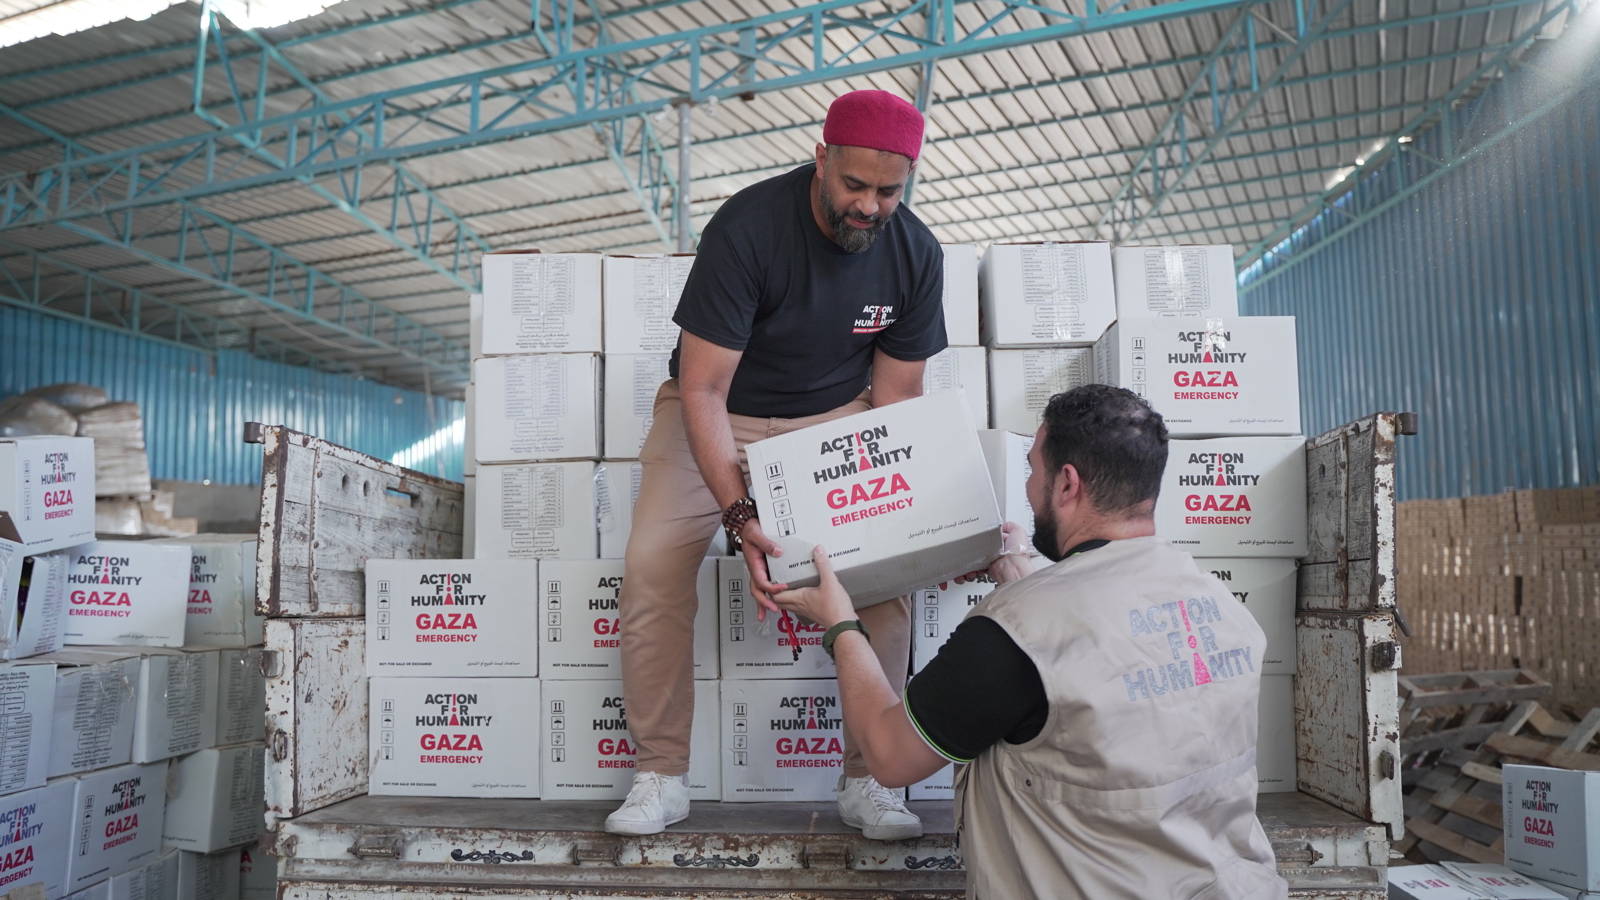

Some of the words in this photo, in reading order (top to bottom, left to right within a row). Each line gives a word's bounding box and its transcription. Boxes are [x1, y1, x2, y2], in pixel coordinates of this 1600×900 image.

[863, 305, 893, 314] ACTION
[1168, 351, 1247, 363] HUMANITY
[1174, 371, 1238, 387] GAZA
[820, 425, 888, 456] ACTION
[45, 452, 68, 464] ACTION
[813, 446, 913, 484] HUMANITY
[1188, 453, 1244, 466] ACTION
[41, 472, 76, 485] HUMANITY
[1179, 474, 1260, 486] HUMANITY
[826, 472, 911, 510] GAZA
[44, 490, 73, 508] GAZA
[1185, 494, 1251, 511] GAZA
[45, 509, 74, 520] EMERGENCY
[831, 497, 914, 526] EMERGENCY
[908, 530, 925, 539] التبديل
[931, 525, 943, 534] للبيع
[833, 547, 861, 557] EXCHANGE
[78, 556, 129, 566] ACTION
[68, 574, 142, 586] HUMANITY
[420, 574, 471, 585] ACTION
[70, 590, 131, 606] GAZA
[188, 590, 212, 603] ZA
[411, 593, 486, 606] HUMANITY
[69, 609, 131, 617] EMERGENCY
[1129, 595, 1222, 638] ACTION
[416, 614, 477, 630] GAZA
[594, 618, 620, 635] GA
[777, 616, 827, 633] GAZ
[1123, 646, 1254, 702] HUMANITY
[425, 694, 477, 705] ACTION
[780, 697, 836, 709] ACTION
[416, 714, 492, 726] HUMANITY
[770, 717, 842, 730] HUMANIT
[420, 734, 483, 750] GAZA
[598, 738, 636, 755] GA
[776, 738, 843, 754] GAZA
[420, 755, 483, 763] EMERGENCY
[776, 759, 843, 768] EMERGENCY
[112, 777, 141, 794] ACTION
[1526, 780, 1551, 793] ACTION
[105, 794, 146, 816] HUMANITY
[1522, 800, 1558, 814] HUMANITY
[0, 804, 36, 825] ACTION
[106, 814, 138, 838] GAZA
[1524, 817, 1554, 836] GAZA
[0, 823, 43, 848] UMANITY
[103, 832, 137, 850] EMERGENCY
[1524, 836, 1555, 849] EMERGENCY
[0, 846, 34, 872] AZA
[0, 866, 33, 886] ERGENCY
